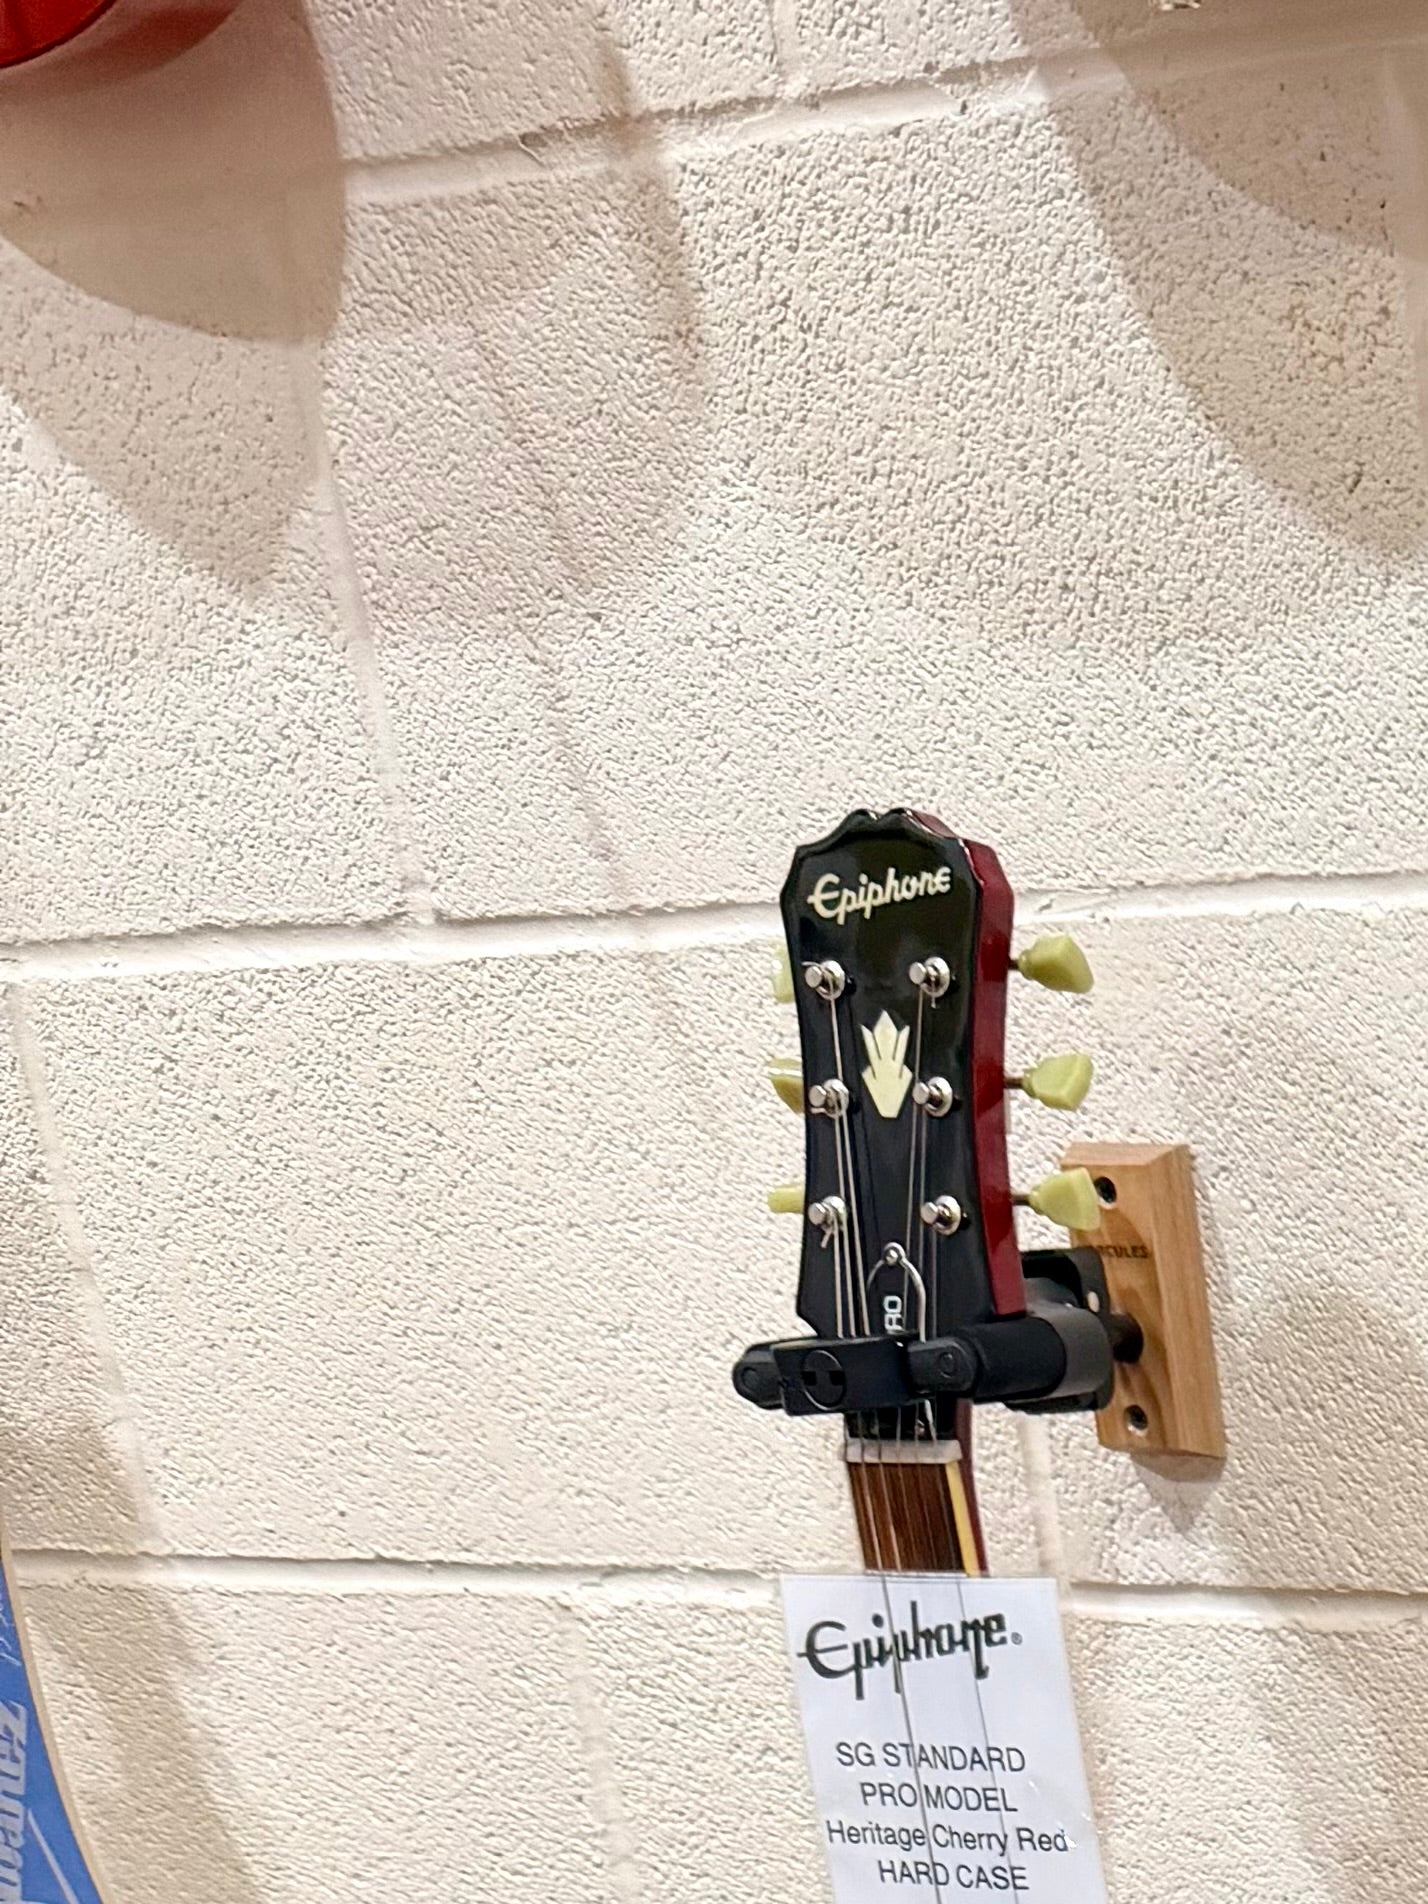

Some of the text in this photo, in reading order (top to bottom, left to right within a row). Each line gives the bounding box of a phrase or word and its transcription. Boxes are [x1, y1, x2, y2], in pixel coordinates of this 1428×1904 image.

[807, 866, 951, 925] Epiphone
[883, 1295, 903, 1336] RO
[797, 1600, 1008, 1700] Epiphone
[836, 1741, 1027, 1773] SG STANDARD
[860, 1781, 1018, 1813] PRO MODEL
[826, 1819, 1069, 1858] Heritage Cherry Red
[878, 1859, 1030, 1891] HARD CASE
